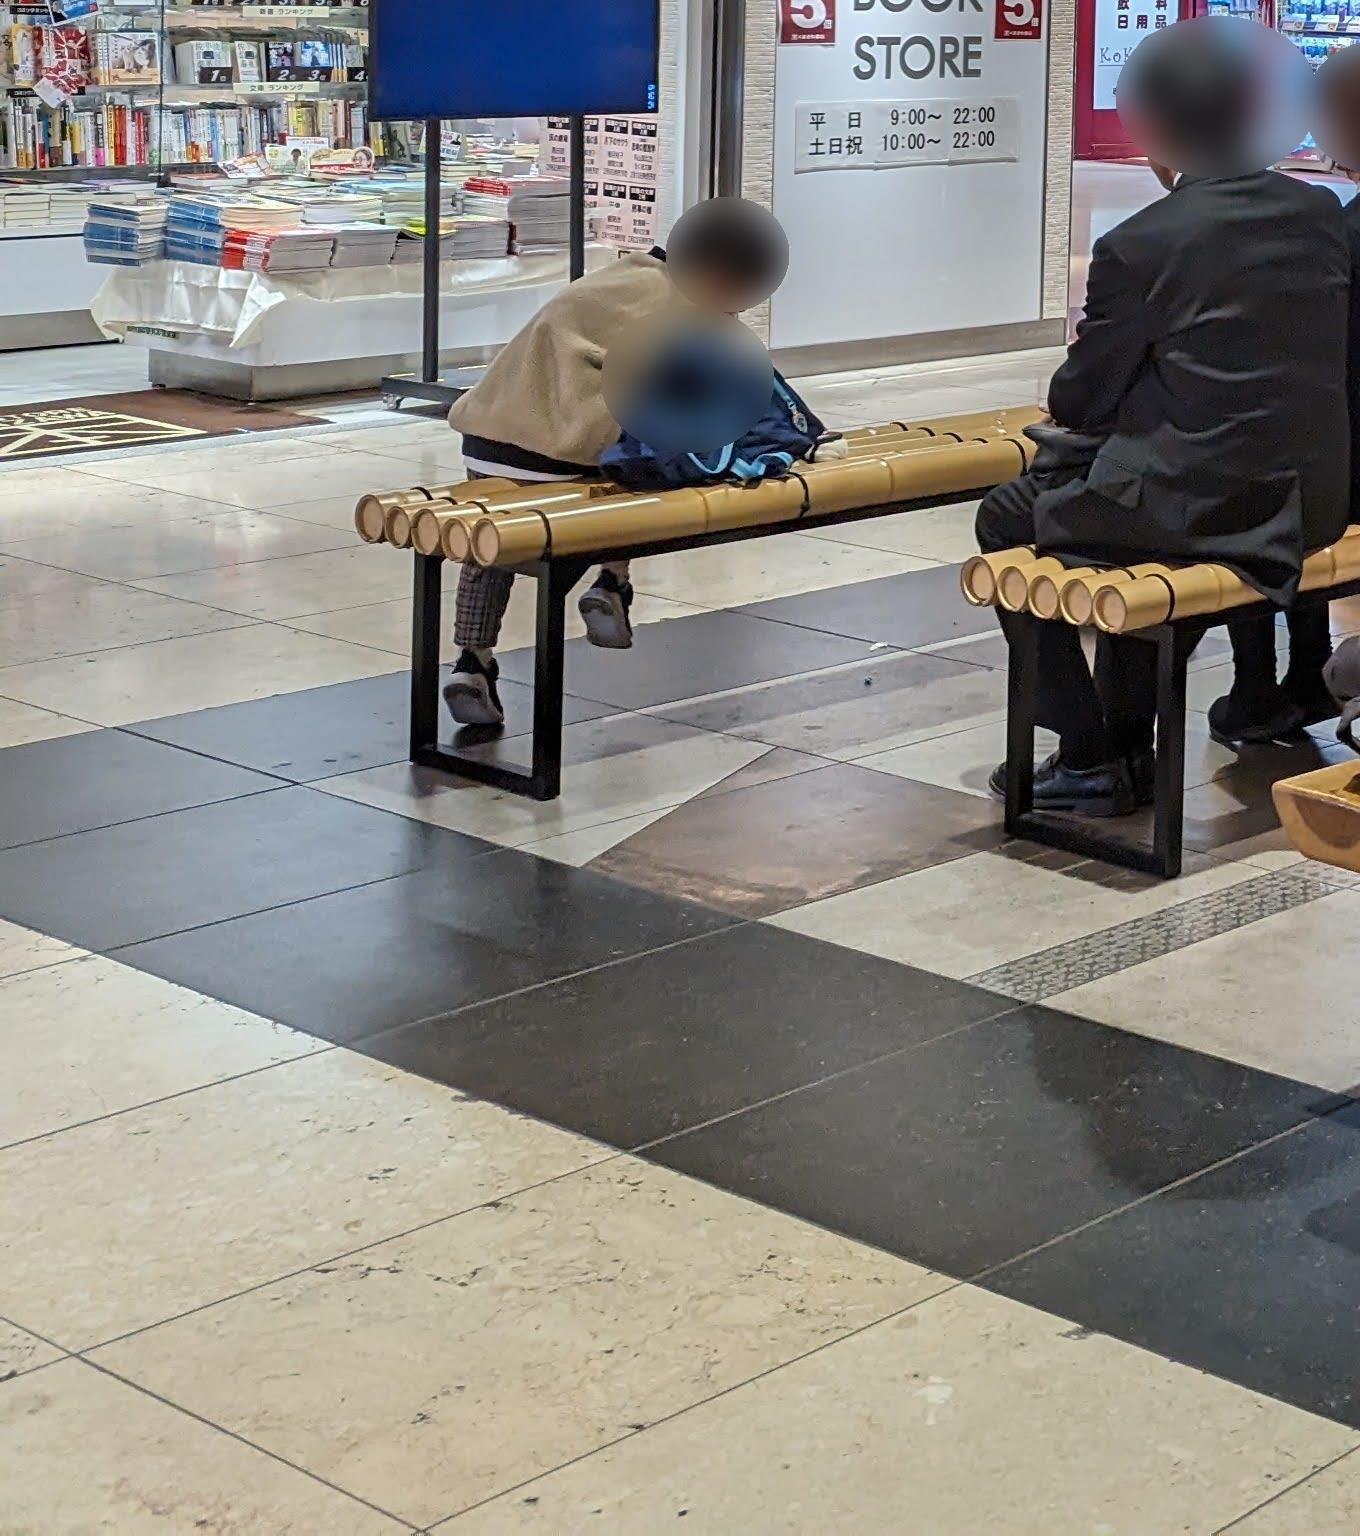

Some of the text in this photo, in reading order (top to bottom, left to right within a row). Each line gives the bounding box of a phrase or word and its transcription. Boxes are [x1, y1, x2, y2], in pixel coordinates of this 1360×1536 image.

[277, 8, 314, 16] ランキング
[852, 34, 983, 81] STORE
[268, 84, 304, 93] ランキング
[953, 107, 995, 124] 22:00
[808, 136, 863, 156] 土日祝
[952, 130, 995, 149] 22:00
